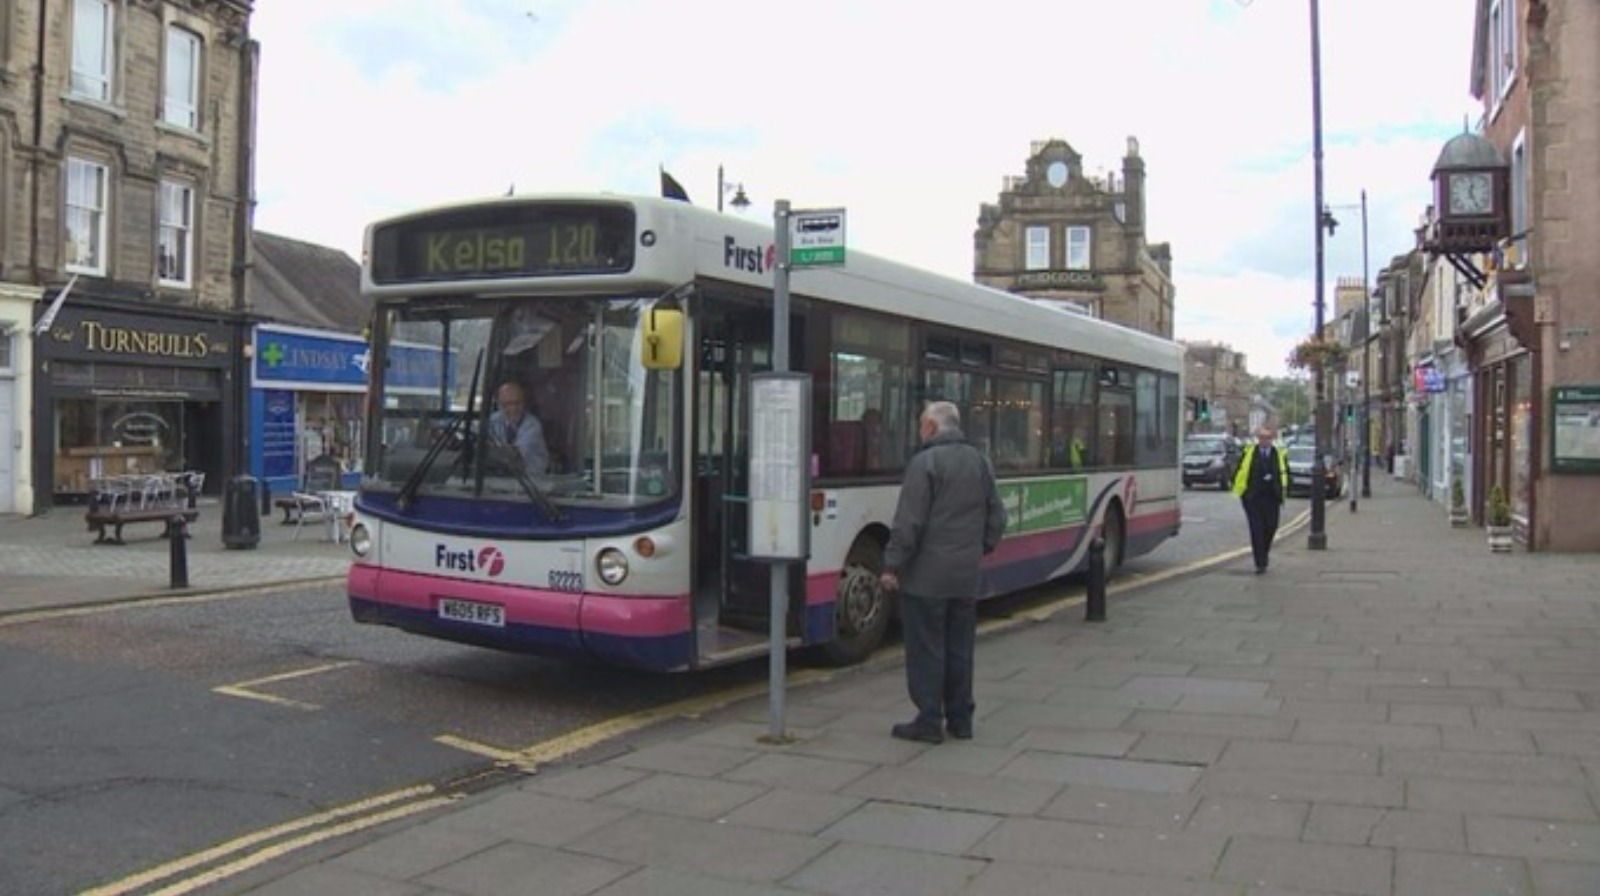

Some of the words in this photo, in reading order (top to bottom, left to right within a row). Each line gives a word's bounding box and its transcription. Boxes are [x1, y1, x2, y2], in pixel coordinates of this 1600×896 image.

[427, 232, 526, 272] Kelso
[548, 223, 596, 265] 120
[724, 235, 763, 274] First
[281, 344, 348, 371] LINDSAY
[436, 543, 475, 572] First
